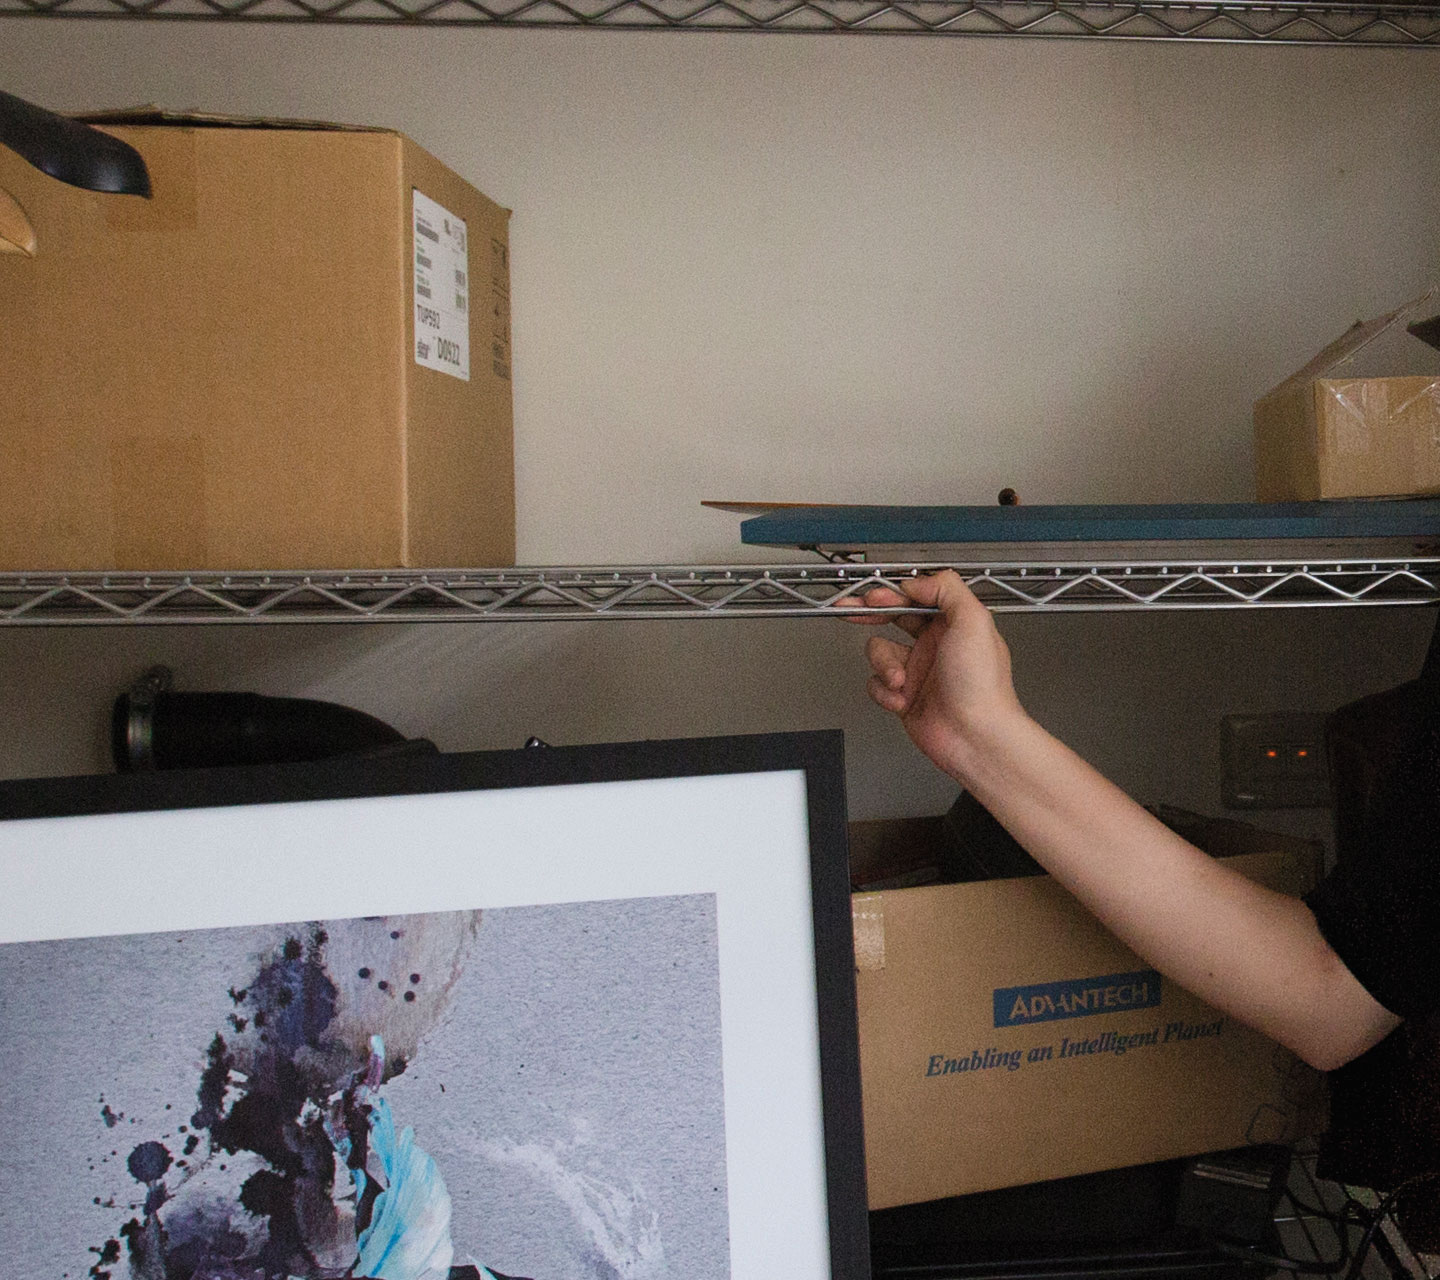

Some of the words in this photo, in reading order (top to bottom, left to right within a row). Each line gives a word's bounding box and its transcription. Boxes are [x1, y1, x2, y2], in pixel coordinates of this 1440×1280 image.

[1009, 982, 1148, 1021] ADVANTECH
[924, 1048, 1022, 1077] Enabling
[1027, 1047, 1053, 1062] an
[1060, 1028, 1158, 1058] Intelligent
